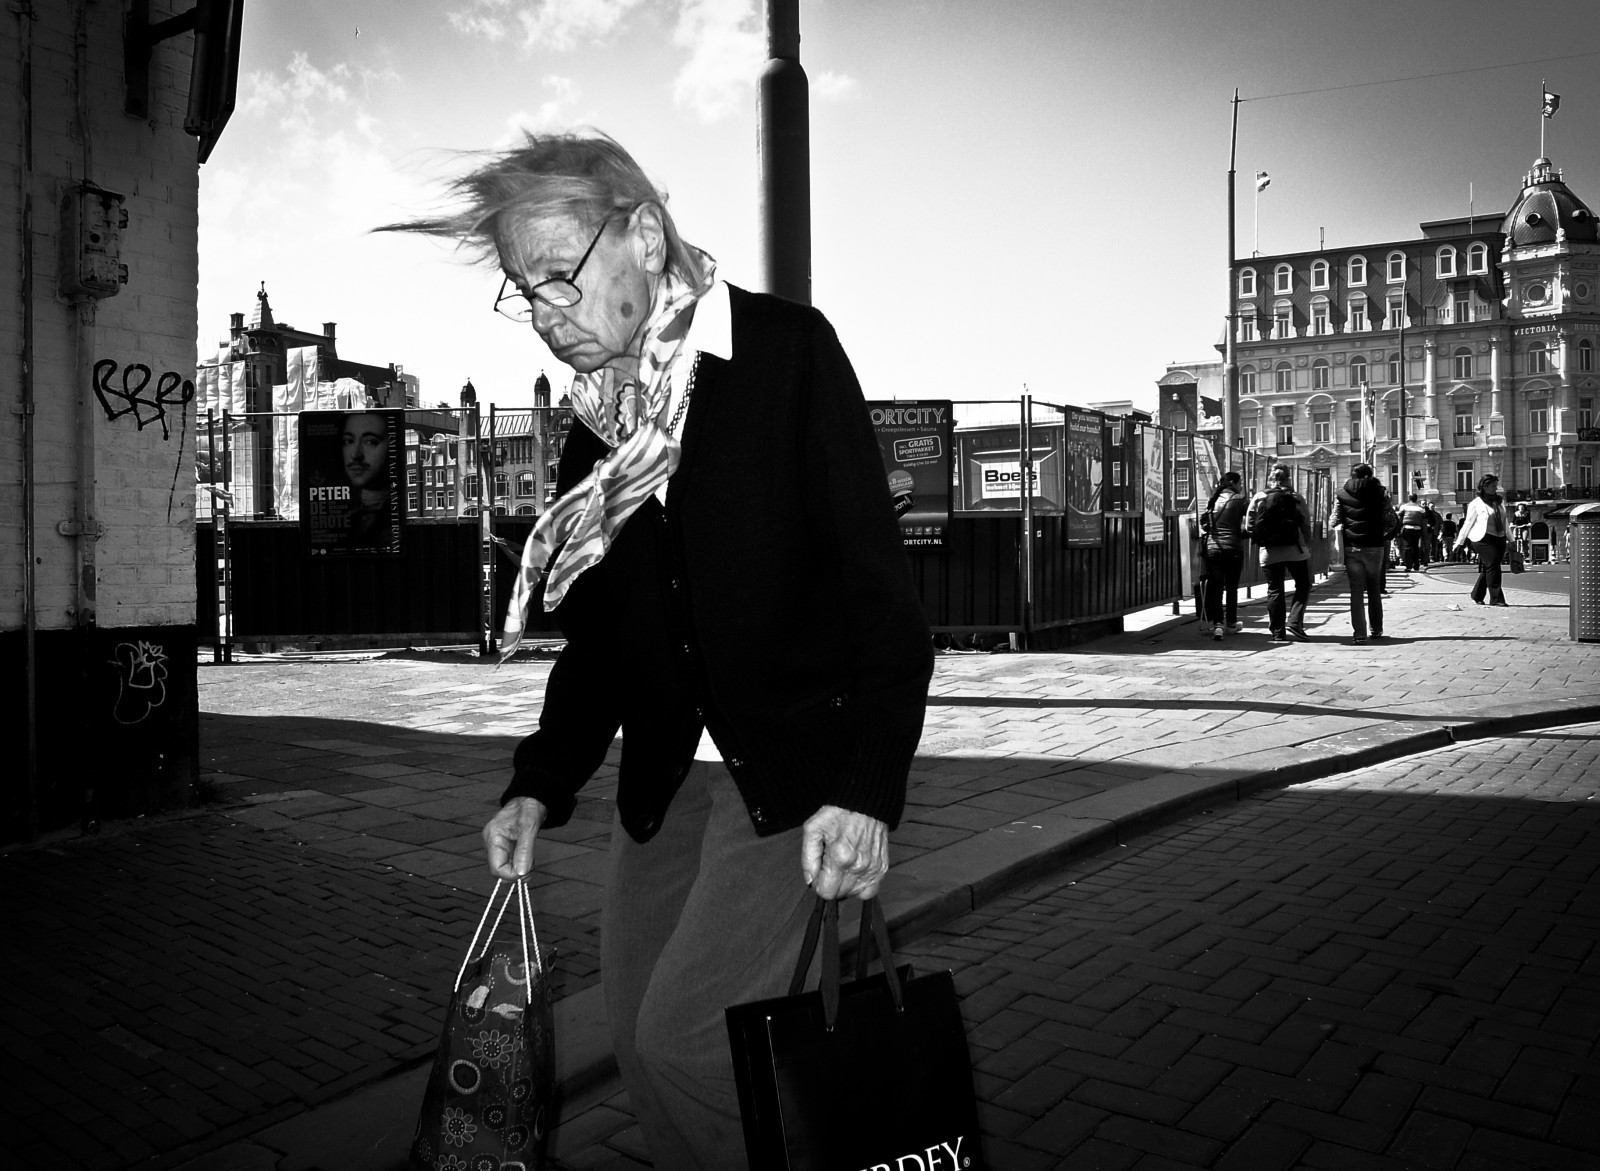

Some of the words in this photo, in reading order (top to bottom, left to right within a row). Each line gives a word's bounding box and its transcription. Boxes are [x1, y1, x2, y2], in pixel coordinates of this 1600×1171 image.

[1513, 324, 1557, 336] VICTORIA
[1573, 323, 1600, 331] HOTEL
[870, 407, 947, 425] ORTCITY.
[387, 416, 398, 482] HERMITAGE
[908, 438, 934, 448] GRATIS
[898, 446, 935, 456] SPORTPAKKET
[985, 470, 1037, 482] Boes
[309, 486, 351, 501] PETER
[310, 501, 327, 515] DE
[310, 514, 352, 529] GROTE
[389, 491, 401, 554] AMSTERDAM
[903, 538, 943, 546] ORTCITY.NL
